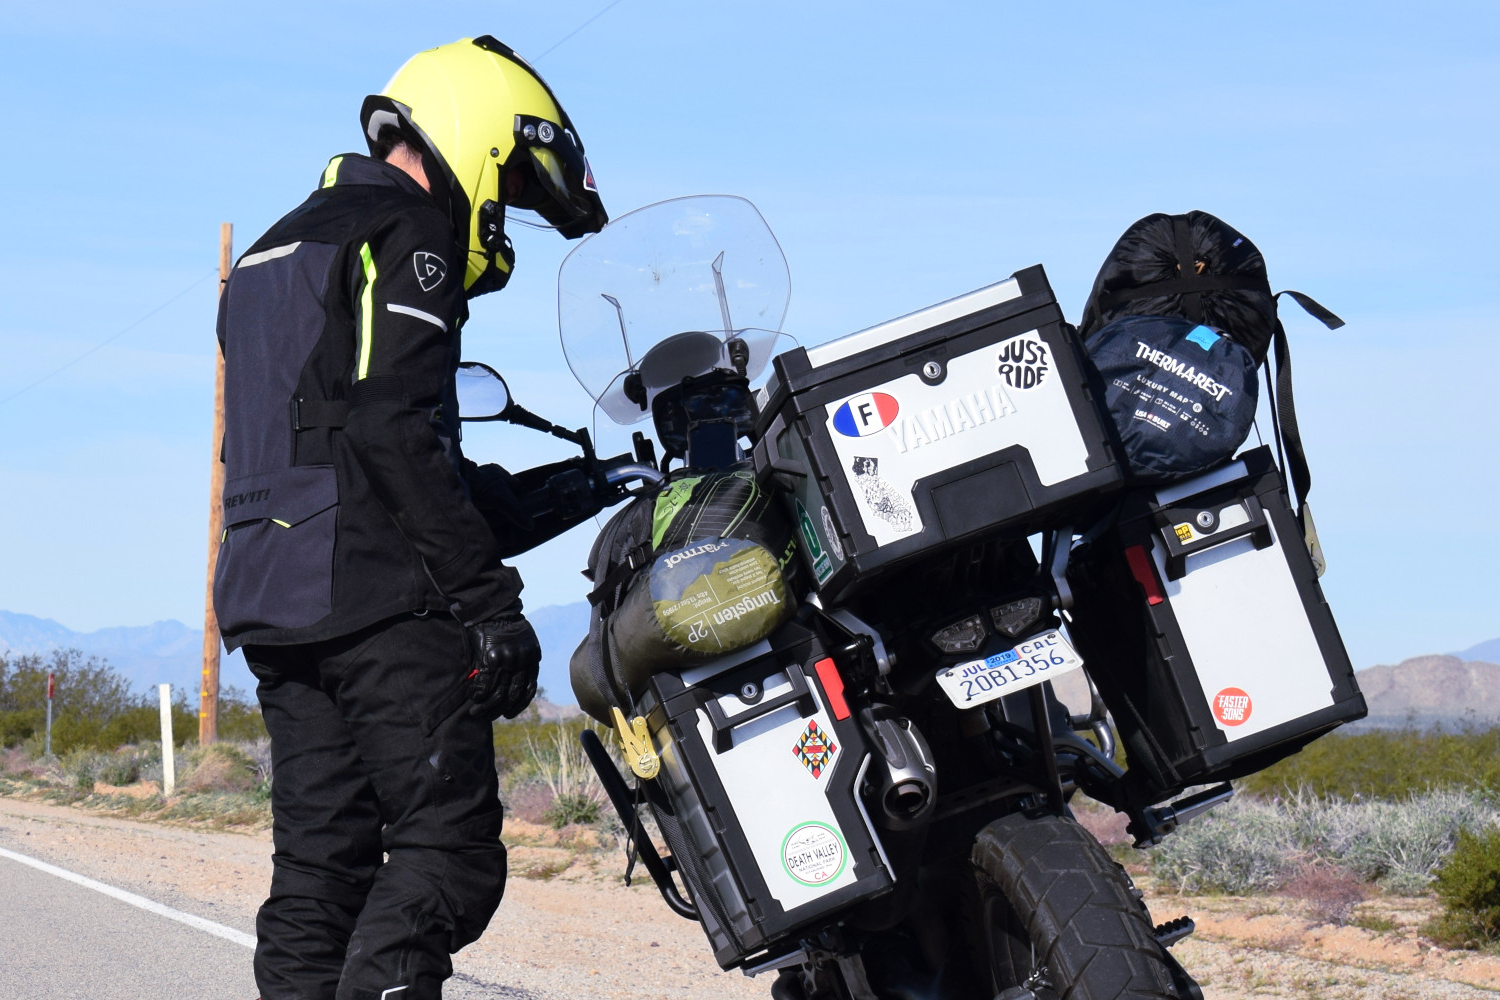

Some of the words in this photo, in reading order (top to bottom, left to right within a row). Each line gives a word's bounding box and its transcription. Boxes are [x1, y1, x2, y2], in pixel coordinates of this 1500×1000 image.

[998, 339, 1048, 366] JUST
[998, 364, 1049, 389] RIDE
[1136, 374, 1169, 393] LUXURY
[857, 402, 873, 427] F
[888, 384, 1017, 454] YAMAHA
[1151, 415, 1171, 429] BUILT
[663, 541, 730, 569] Marmot
[712, 589, 781, 625] Tungsten
[687, 620, 709, 644] 2P
[961, 664, 987, 678] JUL
[989, 652, 1012, 664] 2019
[1021, 638, 1058, 654] CAL
[959, 649, 1065, 698] 20B1356
[1218, 695, 1249, 709] FASTER
[1222, 707, 1245, 720] SONS
[788, 851, 814, 869] DEATH
[813, 842, 839, 860] VALLEY
[814, 871, 828, 880] CA
